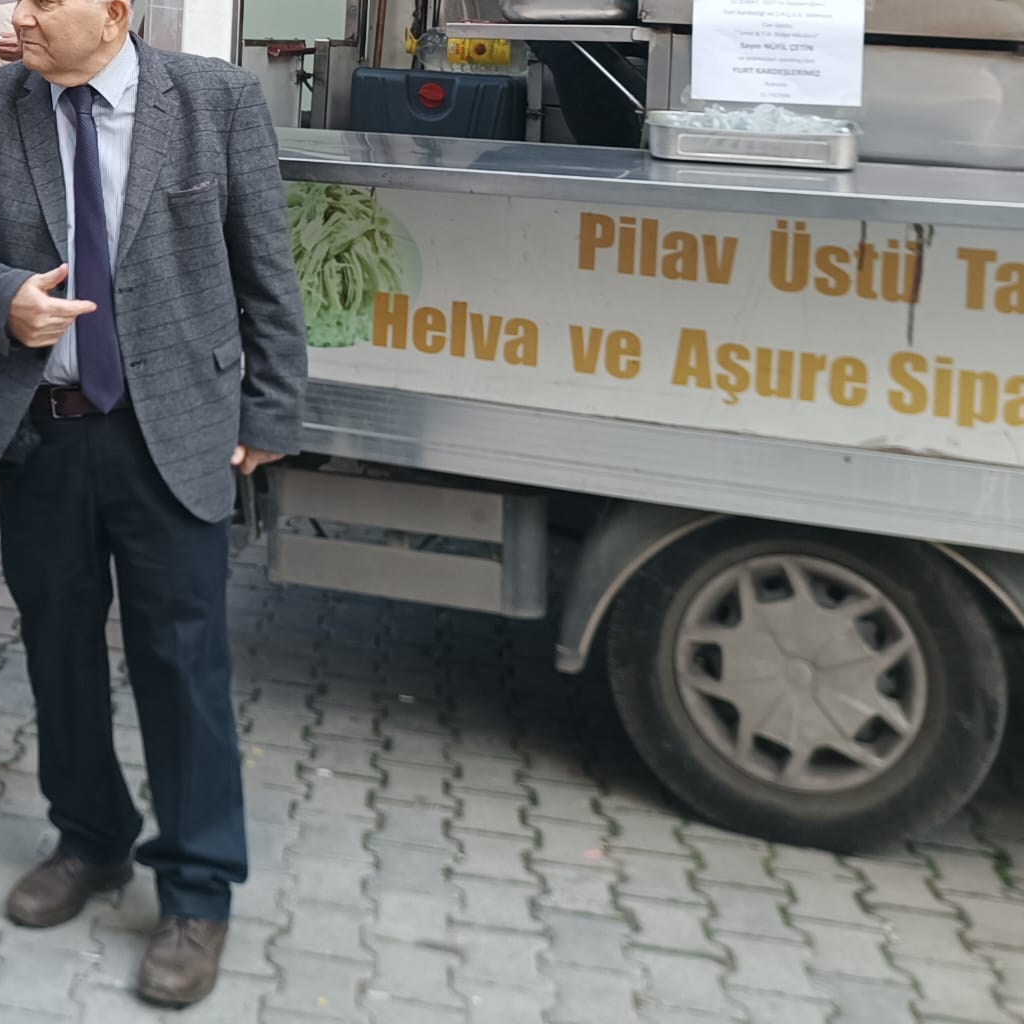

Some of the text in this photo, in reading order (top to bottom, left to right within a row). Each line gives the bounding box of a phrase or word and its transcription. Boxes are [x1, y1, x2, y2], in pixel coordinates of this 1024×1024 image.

[578, 211, 738, 285] Pilav
[768, 220, 921, 303] Üstü
[371, 291, 539, 367] Helva
[569, 324, 642, 379] ve
[671, 327, 869, 405] Aşure
